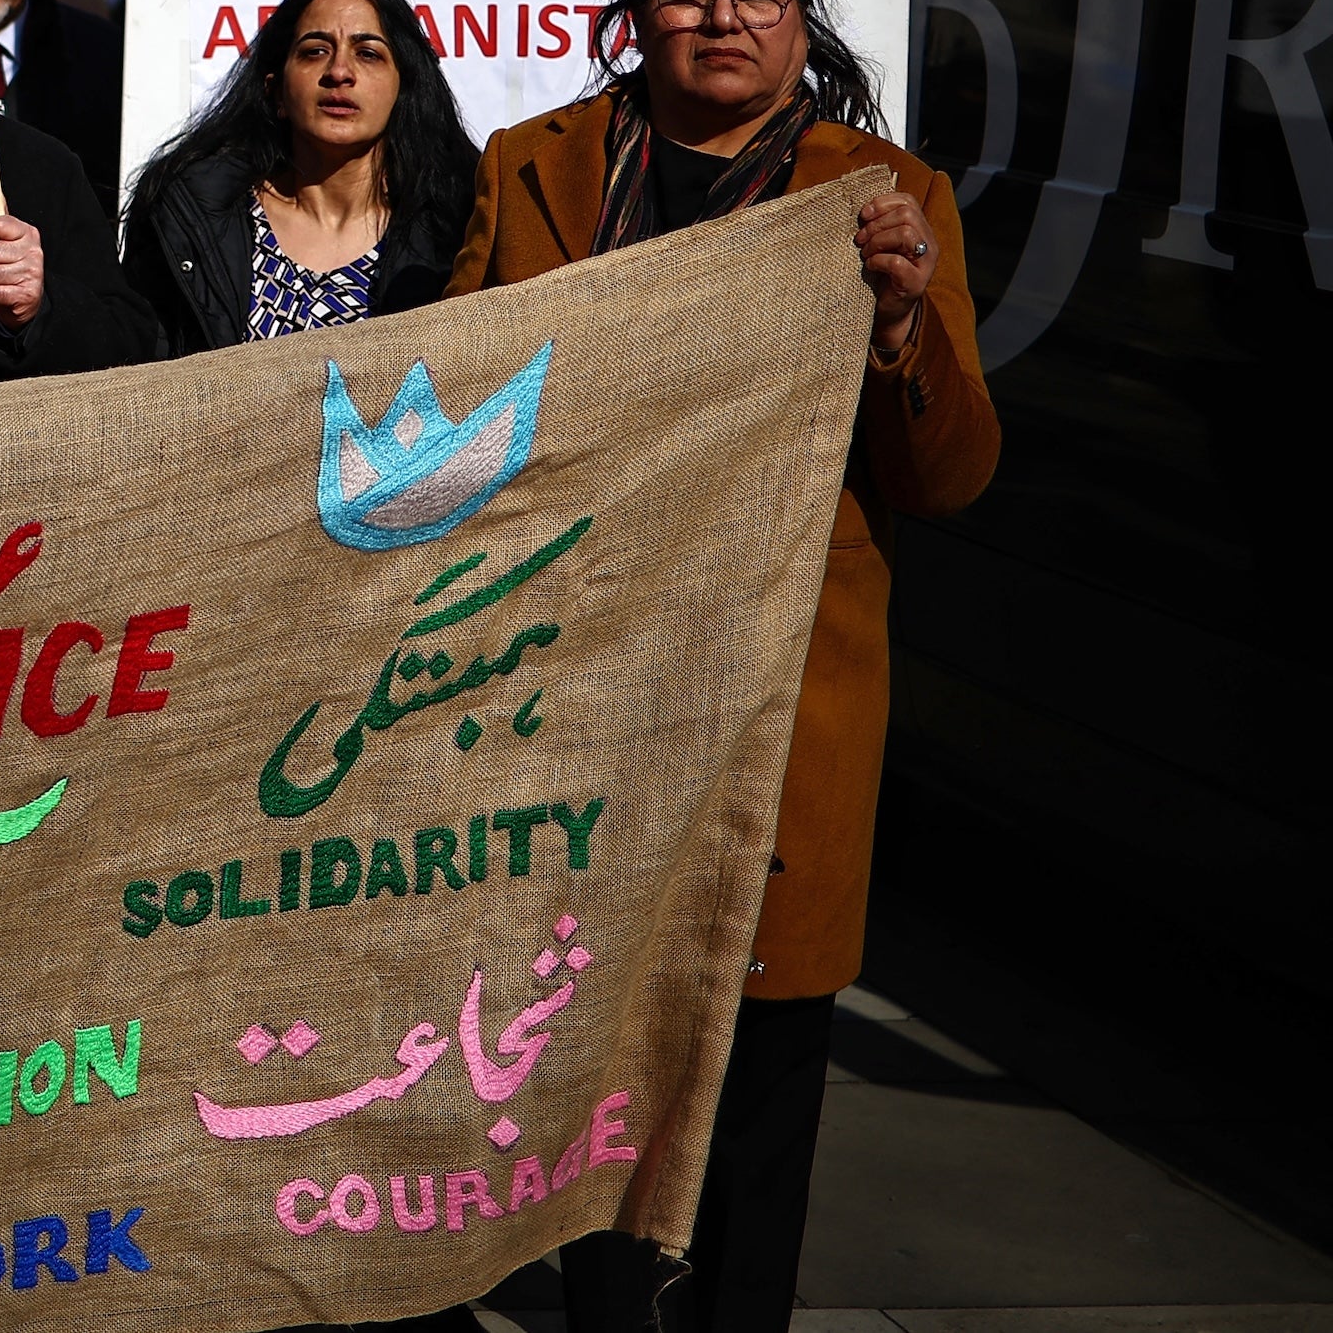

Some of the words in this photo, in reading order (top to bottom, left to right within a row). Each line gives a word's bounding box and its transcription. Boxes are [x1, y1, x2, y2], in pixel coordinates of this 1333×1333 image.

[258, 515, 594, 818] همبستگی
[122, 797, 605, 939] SOLIDARITY
[193, 914, 594, 1150] شجاعت
[275, 1089, 638, 1237] COURAGE
